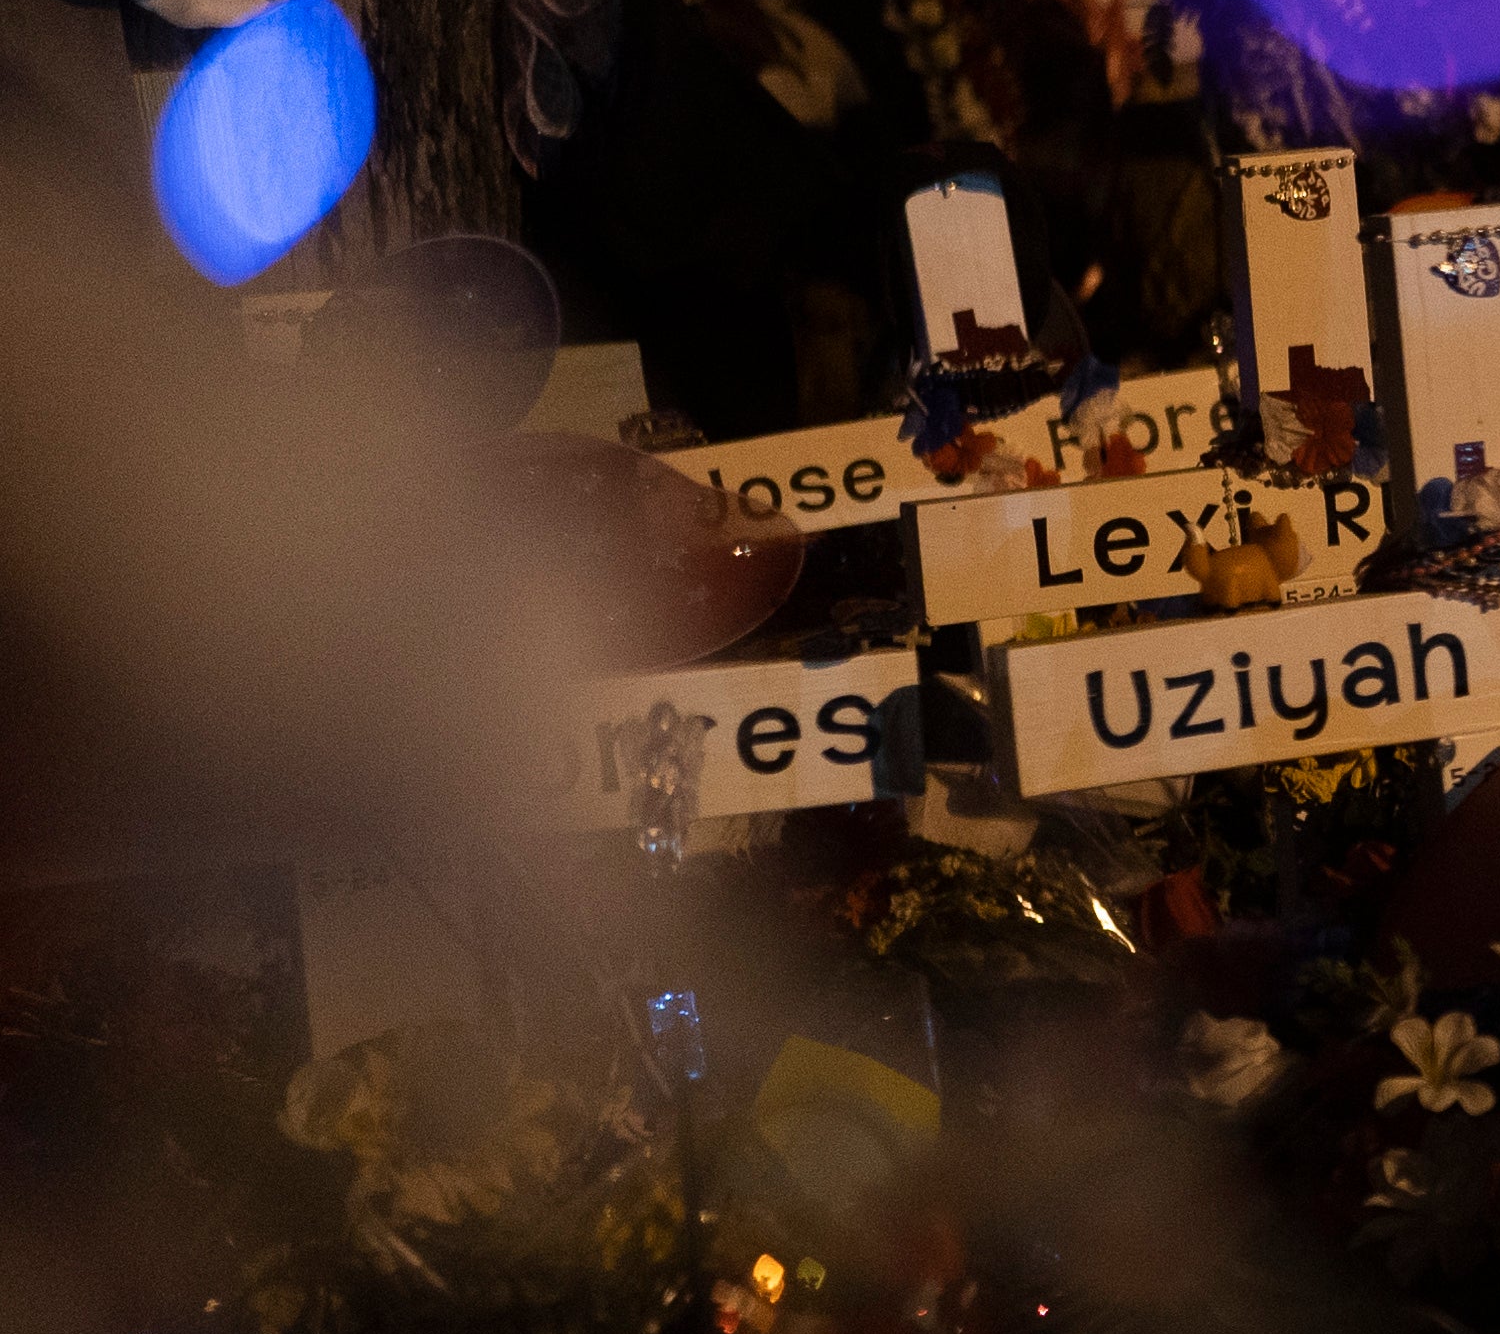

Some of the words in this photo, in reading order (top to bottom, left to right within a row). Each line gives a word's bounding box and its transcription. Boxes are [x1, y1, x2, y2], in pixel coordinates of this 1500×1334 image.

[703, 456, 886, 525] Jose
[1031, 489, 1252, 588] Lexi
[1086, 622, 1469, 749] Uziyah
